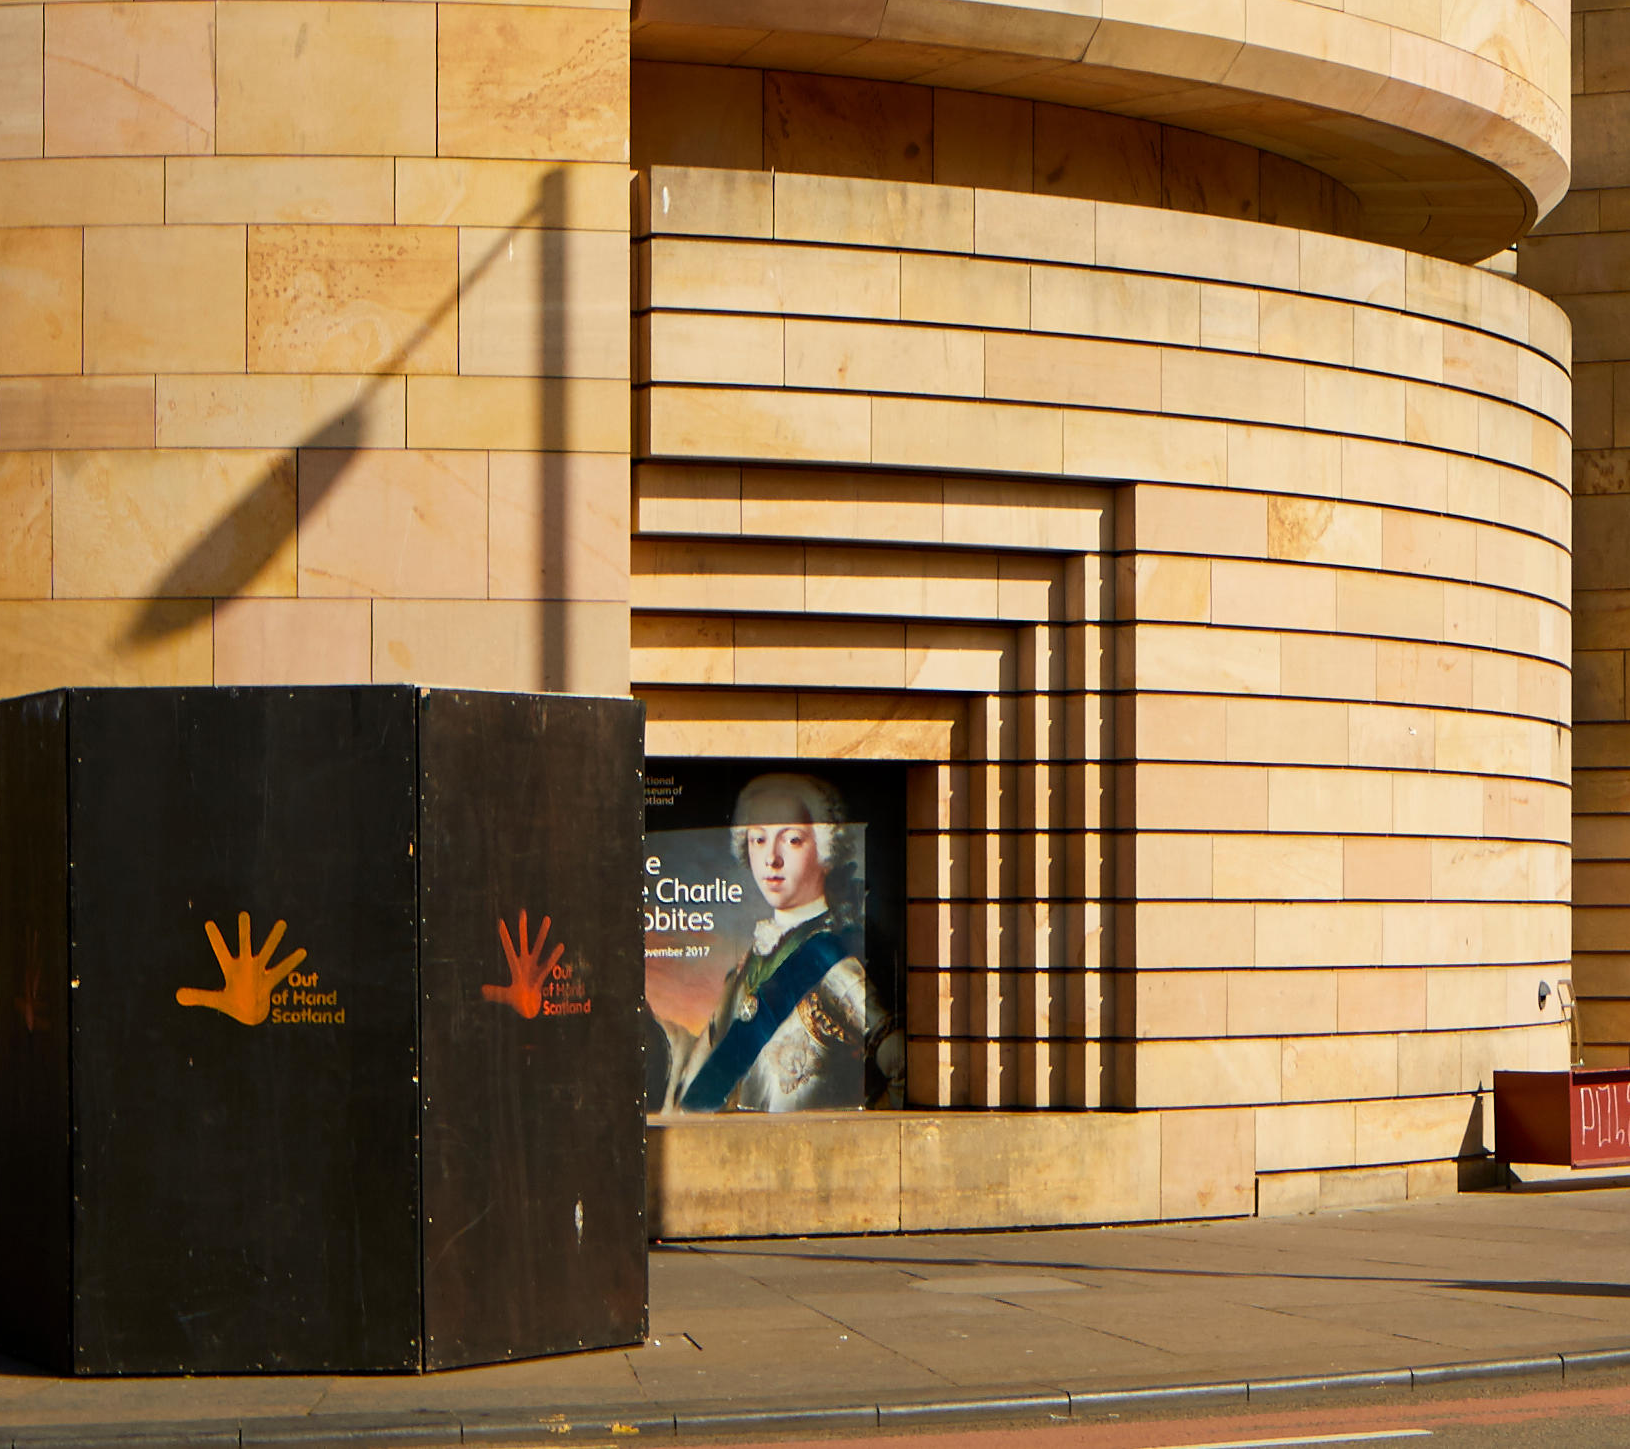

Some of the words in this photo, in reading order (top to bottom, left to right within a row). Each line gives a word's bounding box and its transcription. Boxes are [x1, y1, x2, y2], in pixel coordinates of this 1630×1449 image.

[673, 785, 683, 796] of
[655, 877, 744, 903] Charlie
[685, 946, 710, 958] 2017
[288, 971, 319, 988] Out
[552, 964, 573, 980] Out
[271, 989, 289, 1006] of
[292, 989, 337, 1006] Hand
[272, 1007, 346, 1024] Scotland
[543, 999, 592, 1016] Scotland
